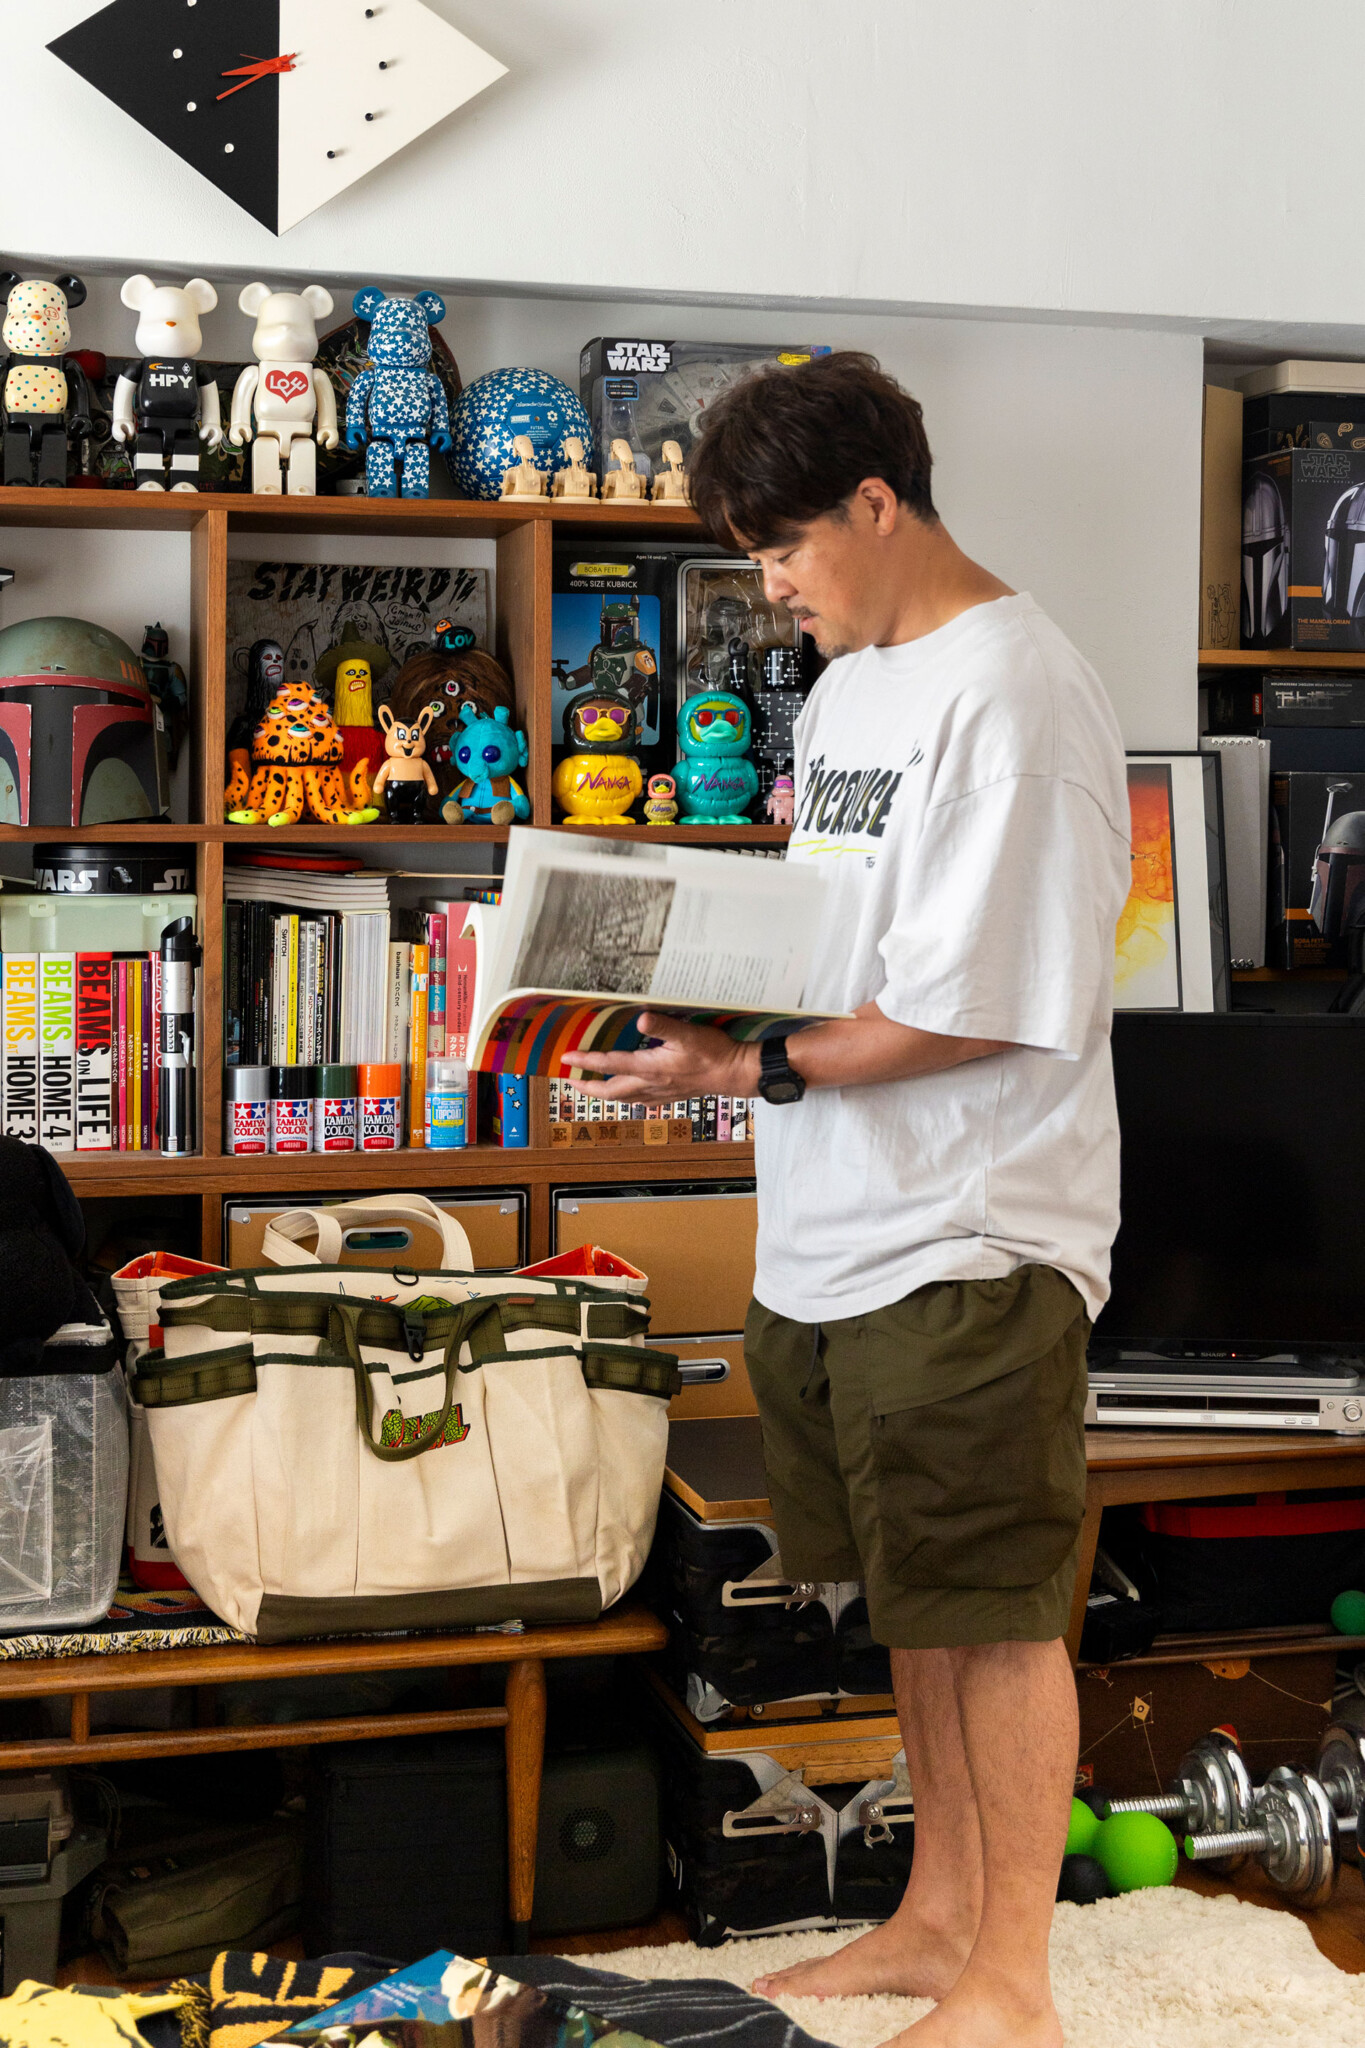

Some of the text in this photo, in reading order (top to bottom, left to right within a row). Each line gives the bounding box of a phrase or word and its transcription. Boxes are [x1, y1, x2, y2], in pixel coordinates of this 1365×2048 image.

[607, 343, 671, 358] STAR
[607, 356, 671, 372] WARS
[149, 373, 194, 389] HPY
[269, 374, 307, 397] LOVE
[1301, 453, 1351, 466] STAR
[1301, 465, 1351, 479] WARS
[584, 566, 619, 574] BOBA FETT
[246, 561, 339, 604] STAY
[606, 581, 638, 589] KUBRICK
[577, 767, 633, 793] NANGA
[692, 767, 747, 793] NANGA
[281, 929, 289, 957] SWITCH
[316, 938, 326, 995] STAR WARS
[433, 973, 441, 993] girard
[433, 994, 441, 1022] designs
[418, 994, 426, 1045] MID-CENTURY
[6, 961, 36, 1140] BEAMS AT HOME 3
[42, 961, 73, 1140] BEAMS AT HOME 4
[78, 961, 111, 1136] BEAMS ON LIFE
[418, 1047, 426, 1081] MODERN
[325, 1115, 354, 1126] TAMIYA
[364, 1114, 395, 1125] TAMIYA
[435, 1109, 462, 1120] TOPCOAT
[234, 1118, 266, 1128] TAMIYA
[276, 1118, 308, 1127] TAMIYA
[363, 1124, 395, 1135] COLOR
[233, 1127, 266, 1137] COLOR
[276, 1126, 308, 1136] COLOR
[324, 1125, 354, 1136] COLOR
[370, 1138, 389, 1146] MINI
